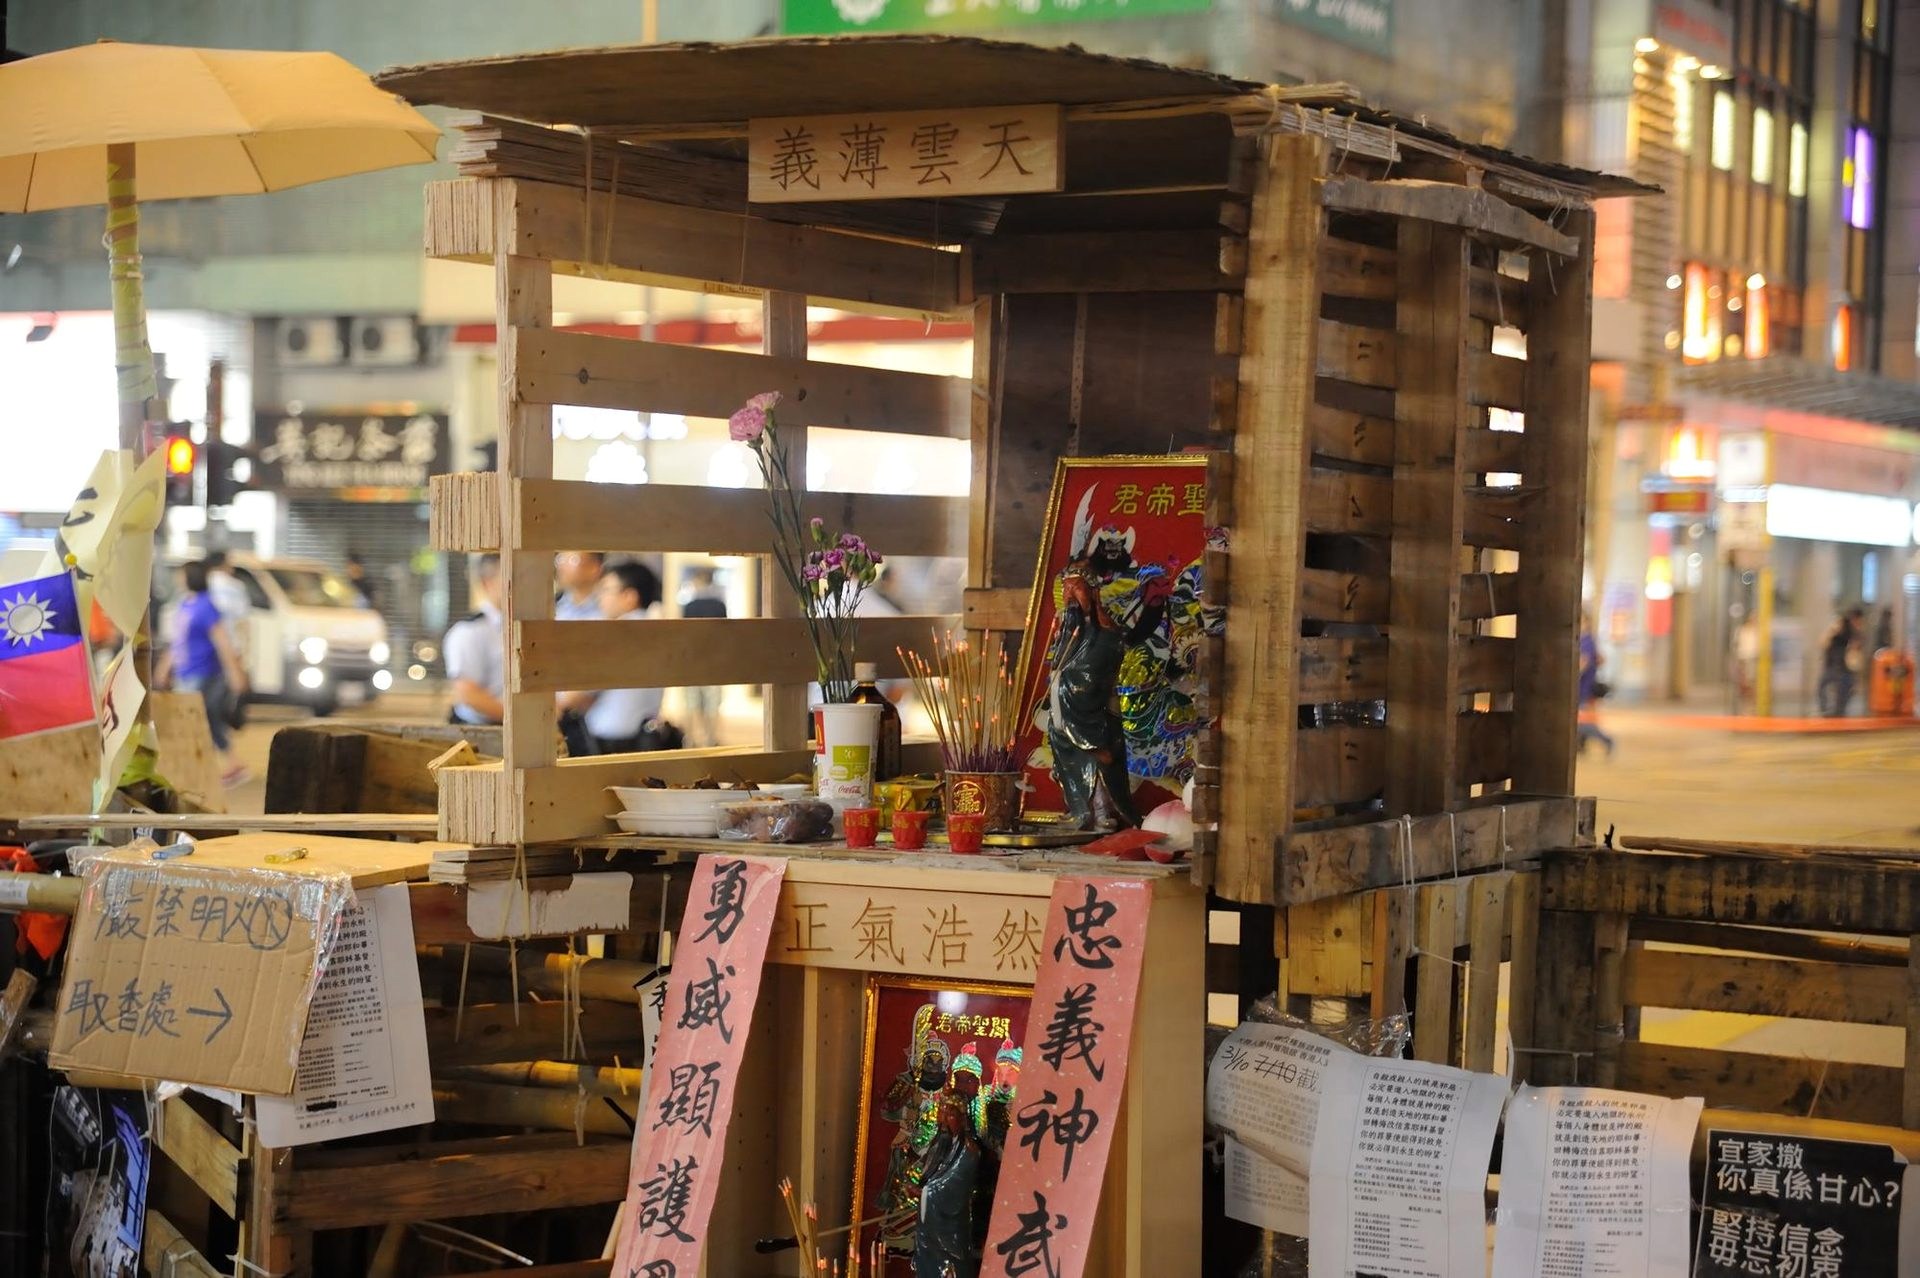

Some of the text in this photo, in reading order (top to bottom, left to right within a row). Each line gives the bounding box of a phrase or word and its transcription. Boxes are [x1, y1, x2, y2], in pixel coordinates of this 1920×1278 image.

[770, 119, 1033, 191] 義薄雲天
[786, 897, 1043, 972] 正氣浩然
[65, 977, 181, 1038] 取香處
[997, 884, 1122, 1278] 忠義神武
[1710, 1209, 1844, 1257] 堅持信念
